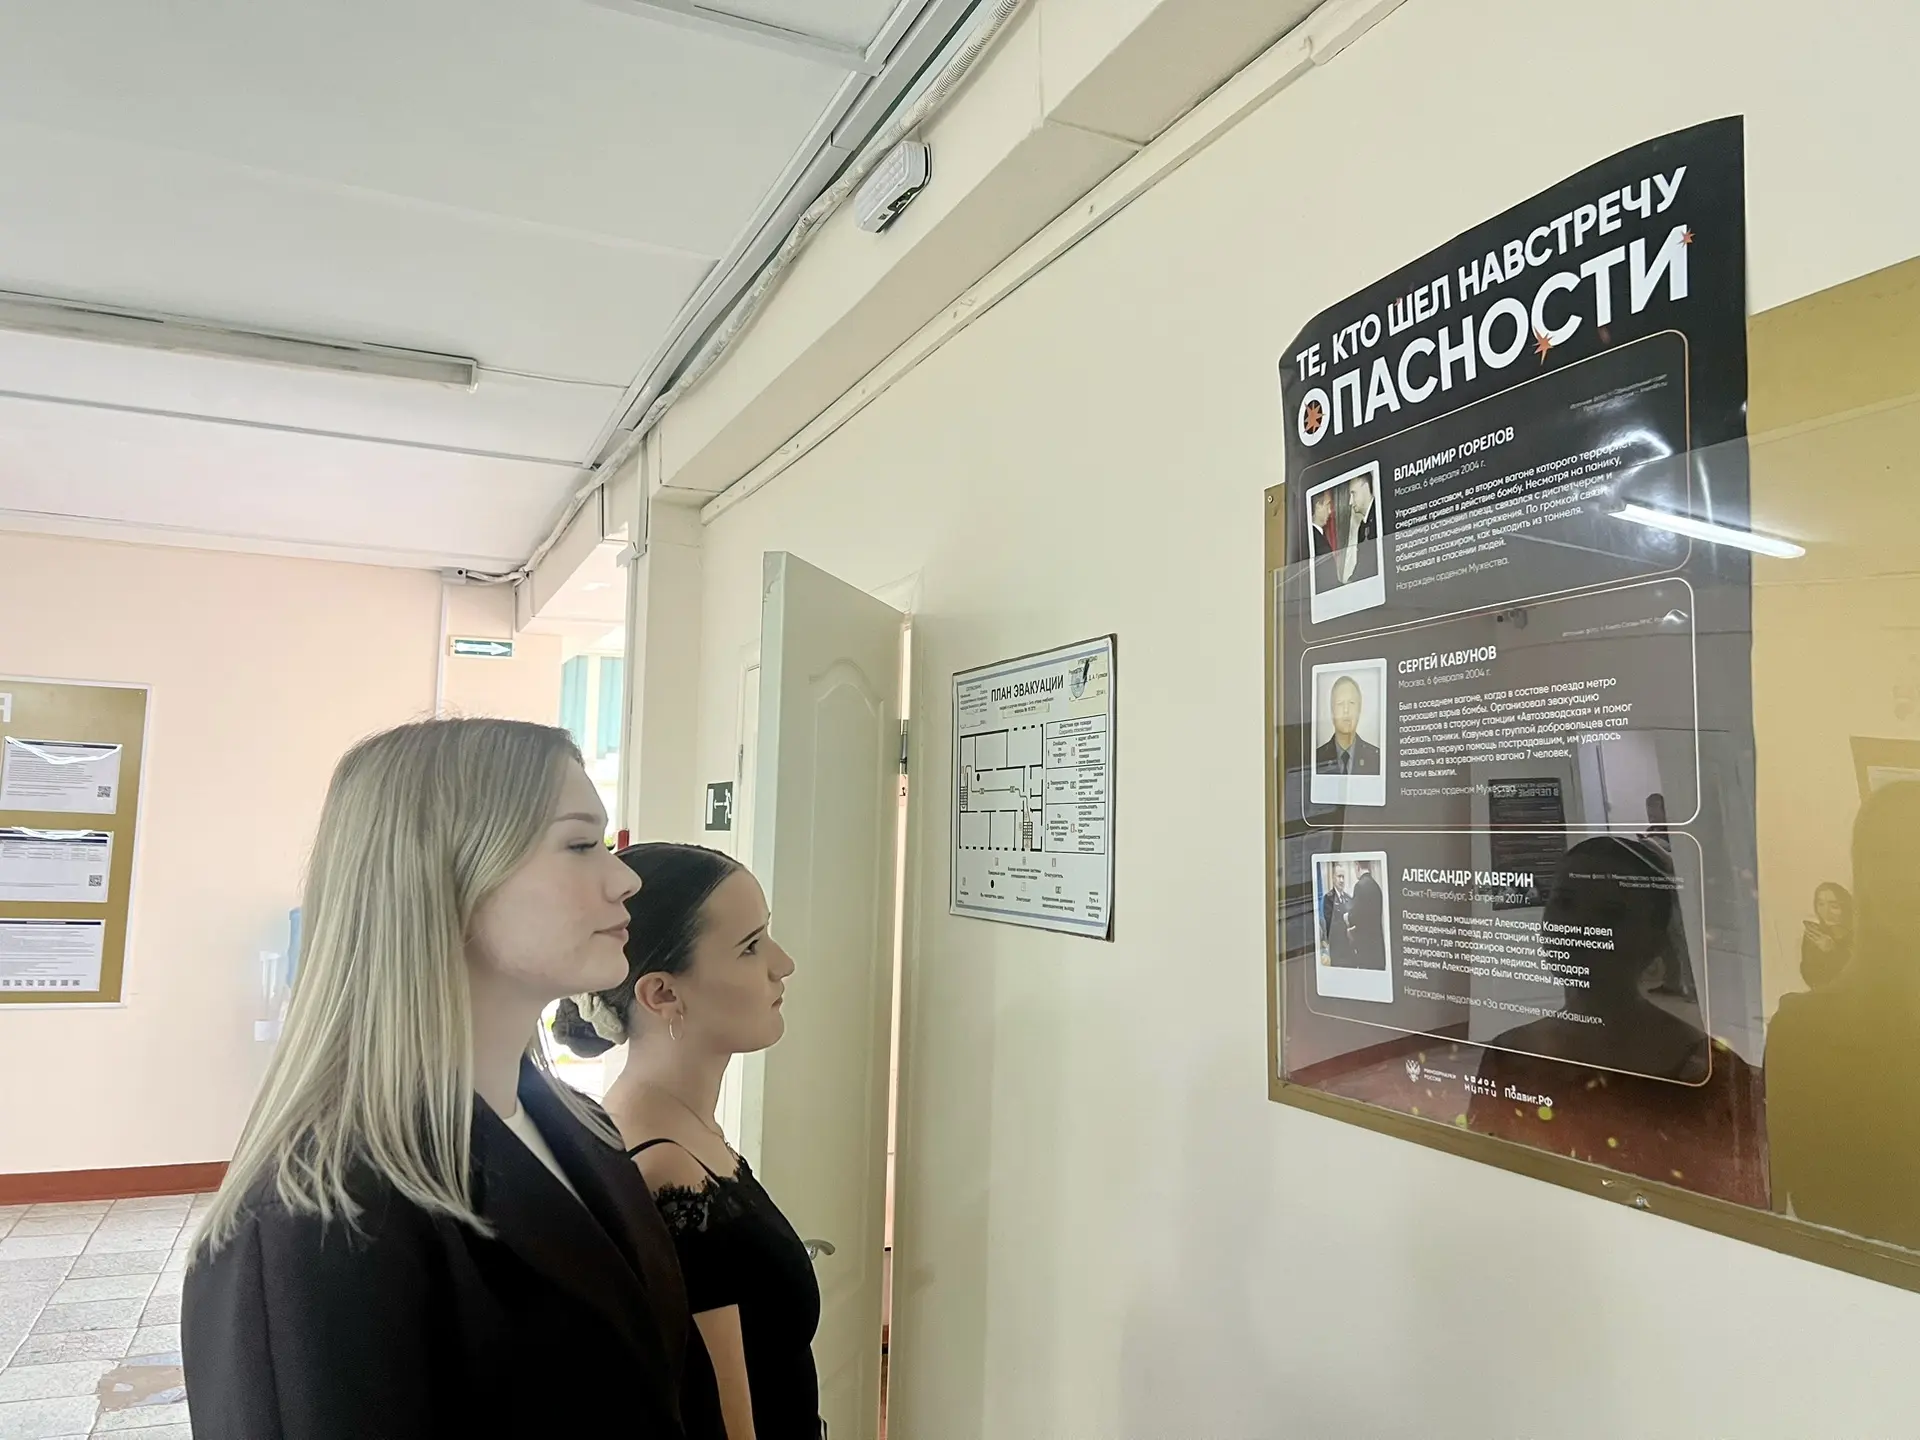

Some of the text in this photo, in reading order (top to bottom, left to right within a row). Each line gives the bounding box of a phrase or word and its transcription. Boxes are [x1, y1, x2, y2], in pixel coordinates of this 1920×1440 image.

[1297, 166, 1686, 381] ТЕ, КТО ШЕЛ НАВСТРЕЧУ
[1297, 224, 1689, 447] ОПАСНОСТИ
[1394, 427, 1514, 481] ВЛАДИМИР ГОРЕЛОВ
[1394, 483, 1422, 496] Москва,
[1429, 469, 1459, 485] февраля
[1461, 460, 1480, 474] 2004
[1481, 460, 1486, 468] г.
[1395, 502, 1427, 518] Управлял
[1429, 492, 1464, 507] составом,
[1465, 487, 1474, 495] во
[1476, 479, 1503, 493] втором
[1505, 469, 1534, 485] вагоне
[1536, 455, 1577, 474] которого
[1395, 456, 1622, 530] смертник привел в действие бомбу. Несмотря на панику,
[1395, 472, 1612, 540] Владимир остановил поезд, связался с диспетчером и
[1395, 537, 1428, 552] дождался
[1430, 524, 1471, 541] отключения
[1473, 510, 1523, 529] напряжения.
[1526, 504, 1538, 514] По
[1540, 493, 1578, 512] громкой
[1396, 506, 1584, 563] объяснил пассажирам, как выходить из тоннеля.
[1396, 557, 1435, 574] Участвовал
[1442, 546, 1476, 562] спасении
[1478, 537, 1506, 553] людей.
[1396, 558, 1509, 591] Награжден орденом Мужества.
[1398, 645, 1496, 673] СЕРГЕЙ КАВУНОВ
[991, 687, 1011, 702] ПЛАН
[1014, 675, 1064, 698] ЭВАКУАЦИИ
[1398, 668, 1491, 688] Москва, 6 февраля 2004 г.
[1399, 702, 1412, 710] Был
[1419, 698, 1453, 709] соседнем
[1455, 694, 1482, 705] вагоне,
[1484, 691, 1506, 702] когда
[1515, 686, 1549, 696] составе
[1551, 682, 1584, 693] поезда
[1586, 677, 1616, 690] метро
[1400, 692, 1599, 723] произошел взрыв бомбы. Организовал эвакуацию
[1400, 723, 1442, 735] пассажиров
[1449, 719, 1480, 730] сторону
[1482, 715, 1515, 726] станции
[1517, 705, 1592, 721] «Автозаводская»
[1594, 706, 1600, 714] и
[1603, 703, 1632, 714] помог
[1400, 734, 1431, 745] избежать
[1433, 732, 1460, 742] паники.
[1462, 729, 1493, 740] Кавунов
[1502, 723, 1535, 737] группой
[1537, 721, 1603, 735] добровольцев
[1605, 716, 1628, 727] стал
[1400, 732, 1620, 756] оказывать первую помощь пострадавшим, им удалось
[1401, 757, 1434, 767] вызволить
[1446, 753, 1494, 765] взорванного
[1496, 752, 1524, 761] вагона
[1526, 750, 1531, 759] 7
[1532, 749, 1572, 759] человек,
[1414, 770, 1427, 778] они
[1428, 768, 1457, 777] выжили.
[1401, 787, 1440, 797] Награжден
[1442, 787, 1474, 796] орденом
[1402, 868, 1533, 888] АЛЕКСАНДР КАВЕРИН
[1402, 888, 1467, 901] Санкт-Петербург,
[1469, 890, 1473, 900] 3
[1475, 893, 1503, 904] апреля
[1505, 894, 1523, 904] 2017
[1403, 910, 1612, 936] После взрыва машинист Александр Каверин довел
[1403, 923, 1614, 950] поврежденный поезд до станции «Технологический
[1403, 936, 1570, 961] институт», где пассажиров смогли быстро
[1403, 947, 1453, 959] эвакуировать
[1461, 953, 1498, 965] передать
[1500, 958, 1539, 969] медикам.
[1541, 960, 1589, 975] Благодаря
[1403, 958, 1590, 989] действиям Александра были спасены десятки
[1404, 970, 1428, 980] людей.
[1404, 987, 1605, 1026] Награжден медалью «За спасение погибавших».
[1504, 1087, 1553, 1107] Подвиг.РФ
